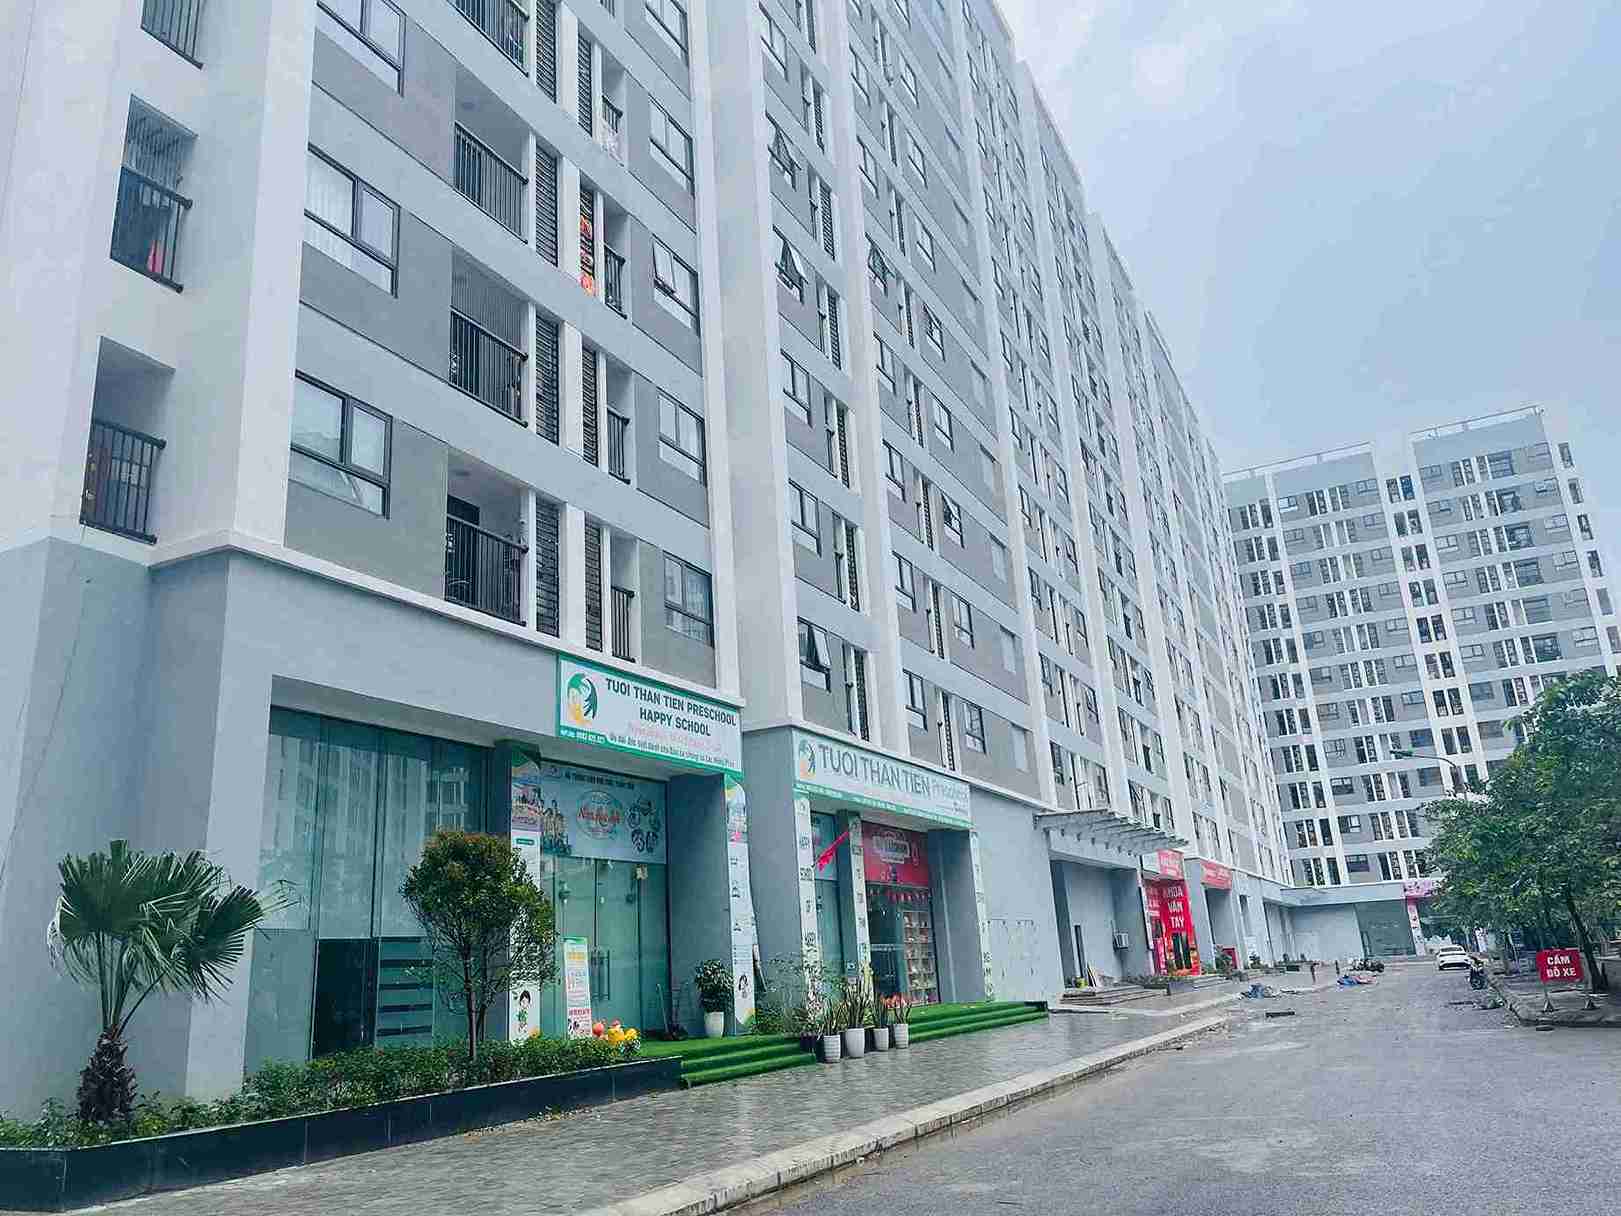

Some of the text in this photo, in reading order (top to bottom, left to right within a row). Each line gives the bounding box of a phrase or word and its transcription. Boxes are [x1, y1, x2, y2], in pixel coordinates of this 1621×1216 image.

[605, 678, 737, 727] TUOI THAN TIEN PRESCHOOL
[640, 707, 711, 737] HAPPY SCHOOL
[818, 744, 858, 777] TUOI
[861, 757, 900, 788] THAN
[901, 769, 930, 795] TIEN
[1562, 967, 1577, 977] XE
